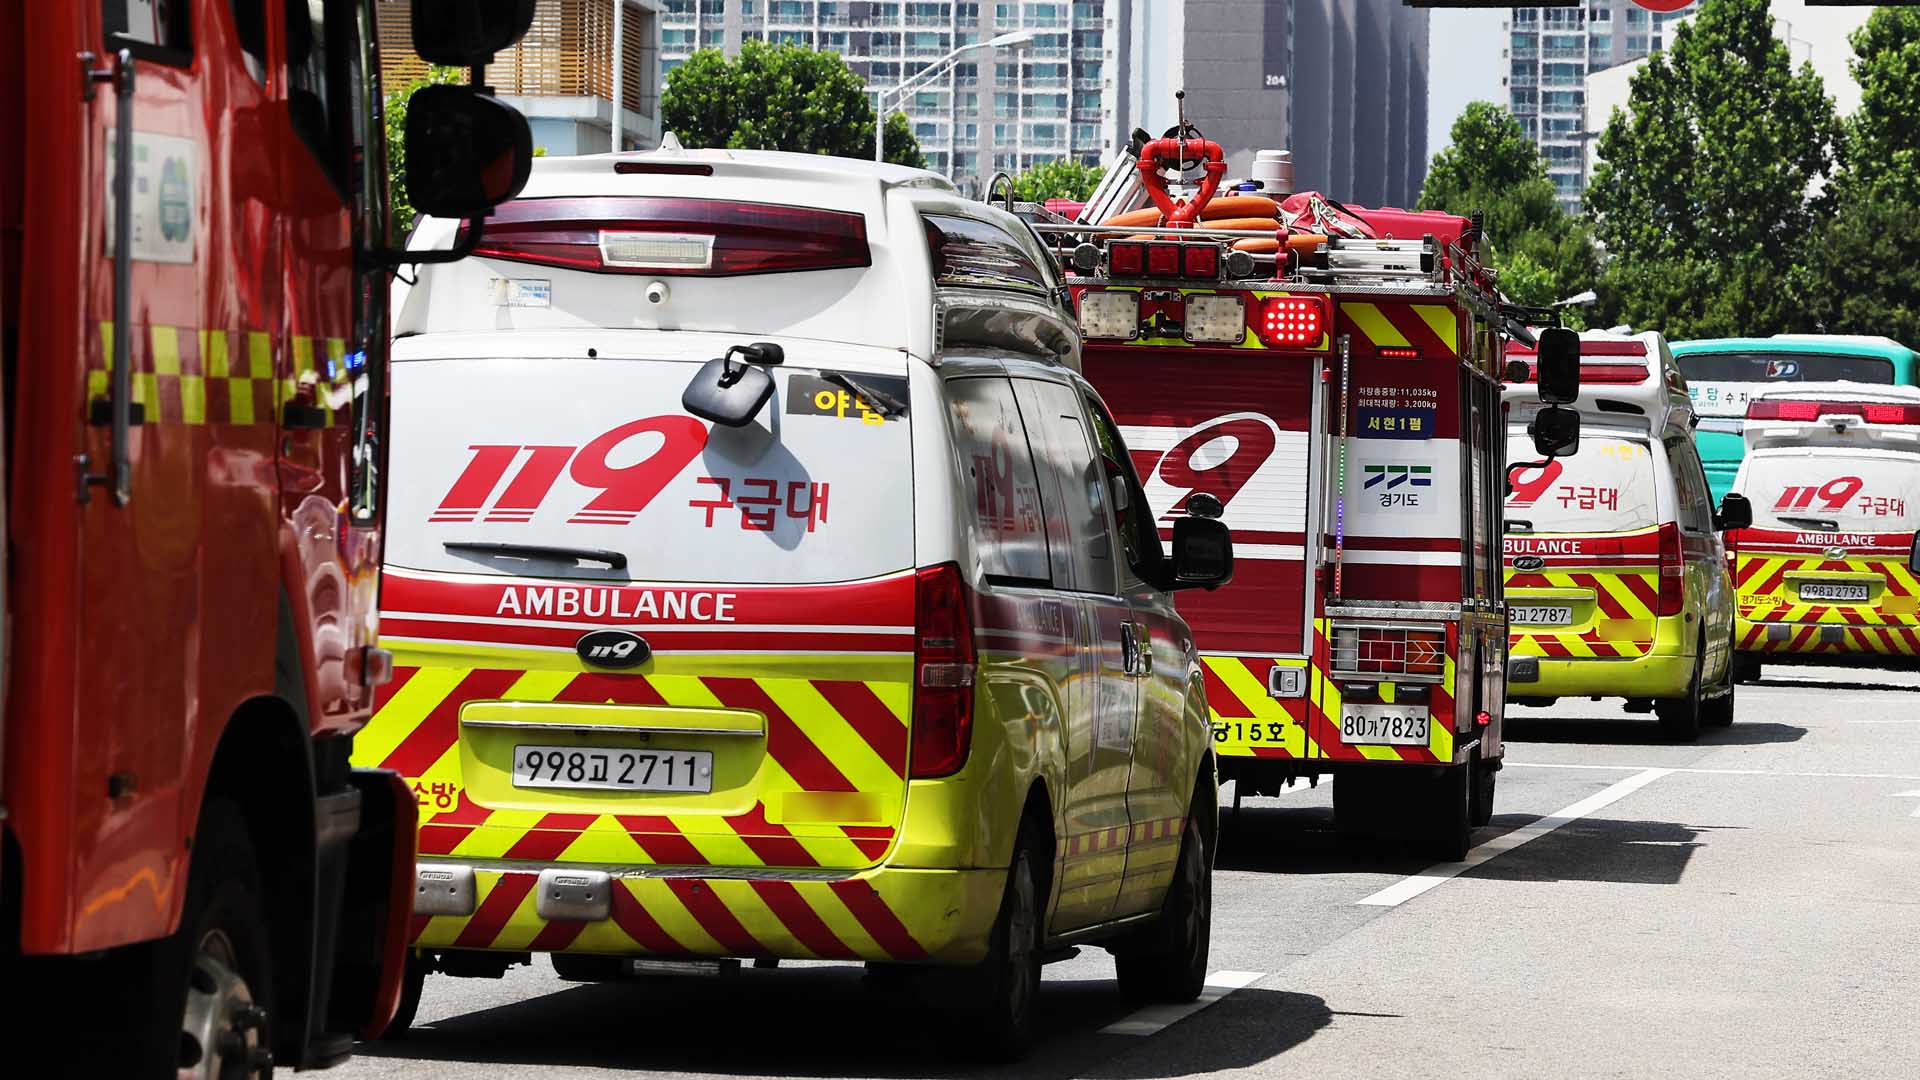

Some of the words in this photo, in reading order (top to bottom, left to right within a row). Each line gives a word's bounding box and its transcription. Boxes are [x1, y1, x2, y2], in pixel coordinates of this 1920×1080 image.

[1404, 400, 1437, 409] 3,200kg
[428, 414, 708, 525] 119
[689, 476, 829, 533] 구급대
[1379, 493, 1419, 507] 경기도
[1556, 486, 1618, 511] 구급대
[1771, 476, 1863, 512] 119
[1858, 496, 1904, 517] 구급대
[1795, 533, 1877, 546] AMBULANCE
[495, 587, 737, 622] AMBULANCE
[588, 640, 638, 658] 119
[1343, 715, 1426, 739] 80가7823
